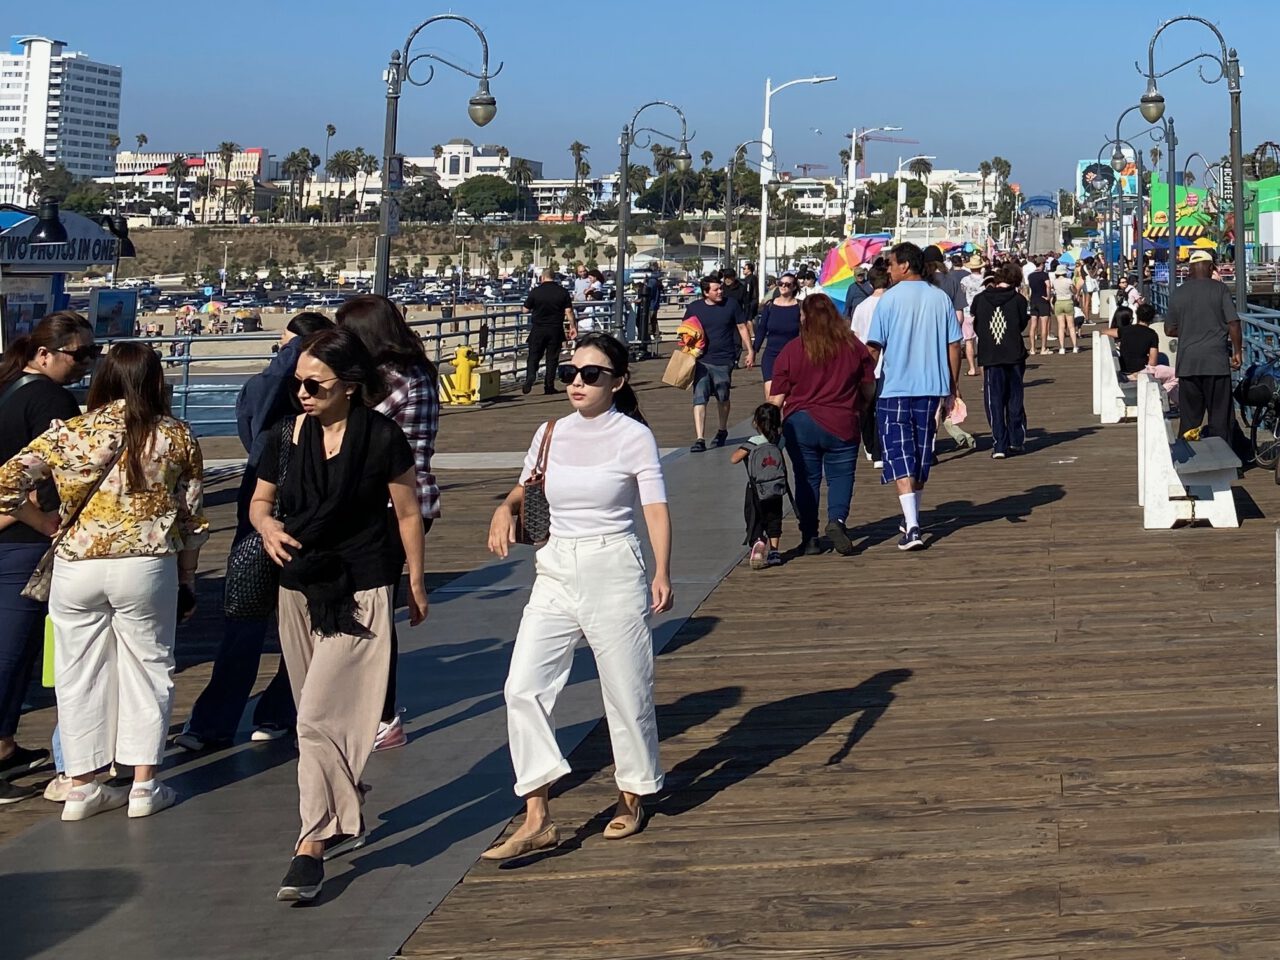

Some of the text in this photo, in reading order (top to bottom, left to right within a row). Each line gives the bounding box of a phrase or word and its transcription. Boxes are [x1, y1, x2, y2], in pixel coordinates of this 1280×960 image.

[0, 236, 27, 260] TWO
[78, 239, 91, 260] IN
[92, 239, 115, 260] ONE
